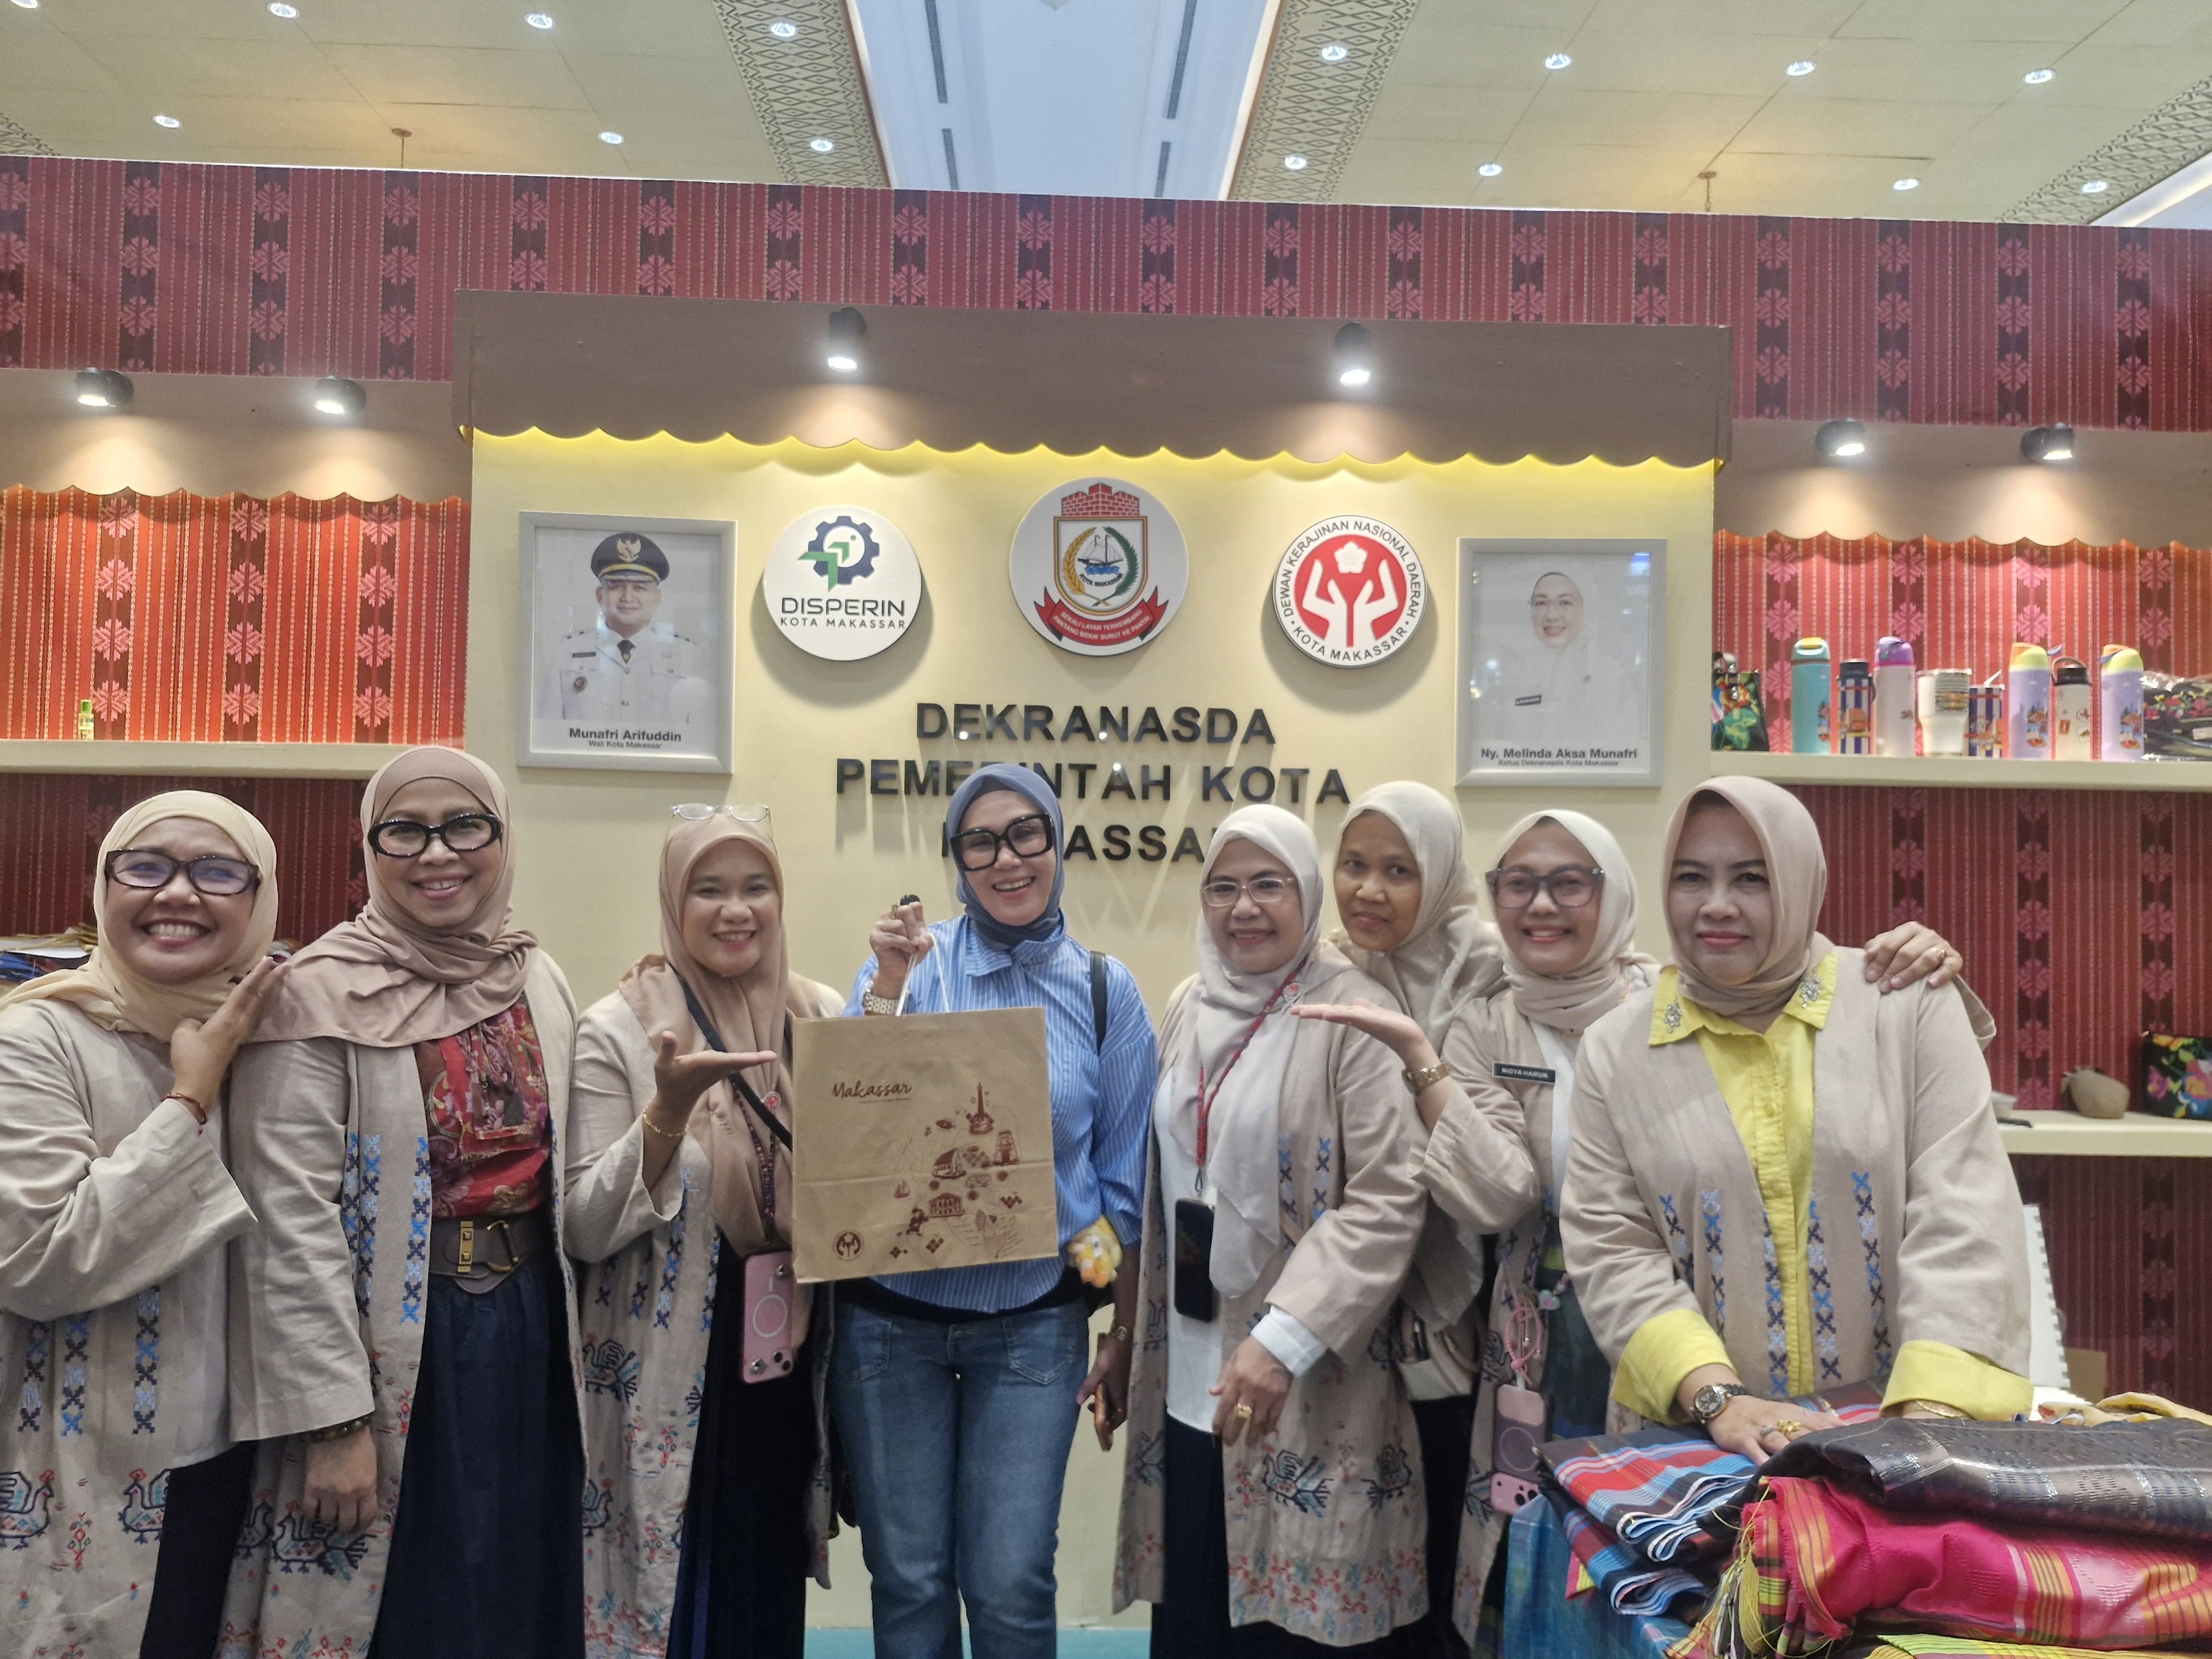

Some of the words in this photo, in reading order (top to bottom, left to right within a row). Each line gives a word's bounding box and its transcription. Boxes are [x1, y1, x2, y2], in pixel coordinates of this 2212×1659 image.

[1280, 569, 1294, 617] DEWAN
[1287, 520, 1349, 567] KERAJINAN
[1353, 520, 1410, 563] NASIONAL
[1406, 562, 1421, 618] DAERAH
[781, 597, 906, 617] DISPERIN
[780, 617, 818, 627] KOTA
[826, 618, 906, 629] MAKASSAR
[1053, 615, 1079, 635] PANTANG
[1079, 631, 1099, 640] BIDUK
[1099, 632, 1121, 640] SURUT
[1131, 615, 1151, 633] PANTAI
[1060, 611, 1081, 627] SEKALI
[1103, 609, 1144, 630] TERKEMBANG
[1293, 626, 1326, 656] KOTA
[1330, 627, 1407, 661] MAKASSAR
[916, 702, 1276, 744] DEKRANASDA
[570, 728, 619, 740] Munafri
[623, 730, 681, 742] Arifuddin
[1481, 748, 1499, 760] Ny.
[1503, 748, 1552, 758] Melinda
[1556, 749, 1585, 759] Aksa
[1590, 749, 1637, 759] Munafri
[837, 759, 1171, 800] PEMENTAH
[1202, 766, 1351, 804] KOTA
[832, 1080, 912, 1098] Makassar
